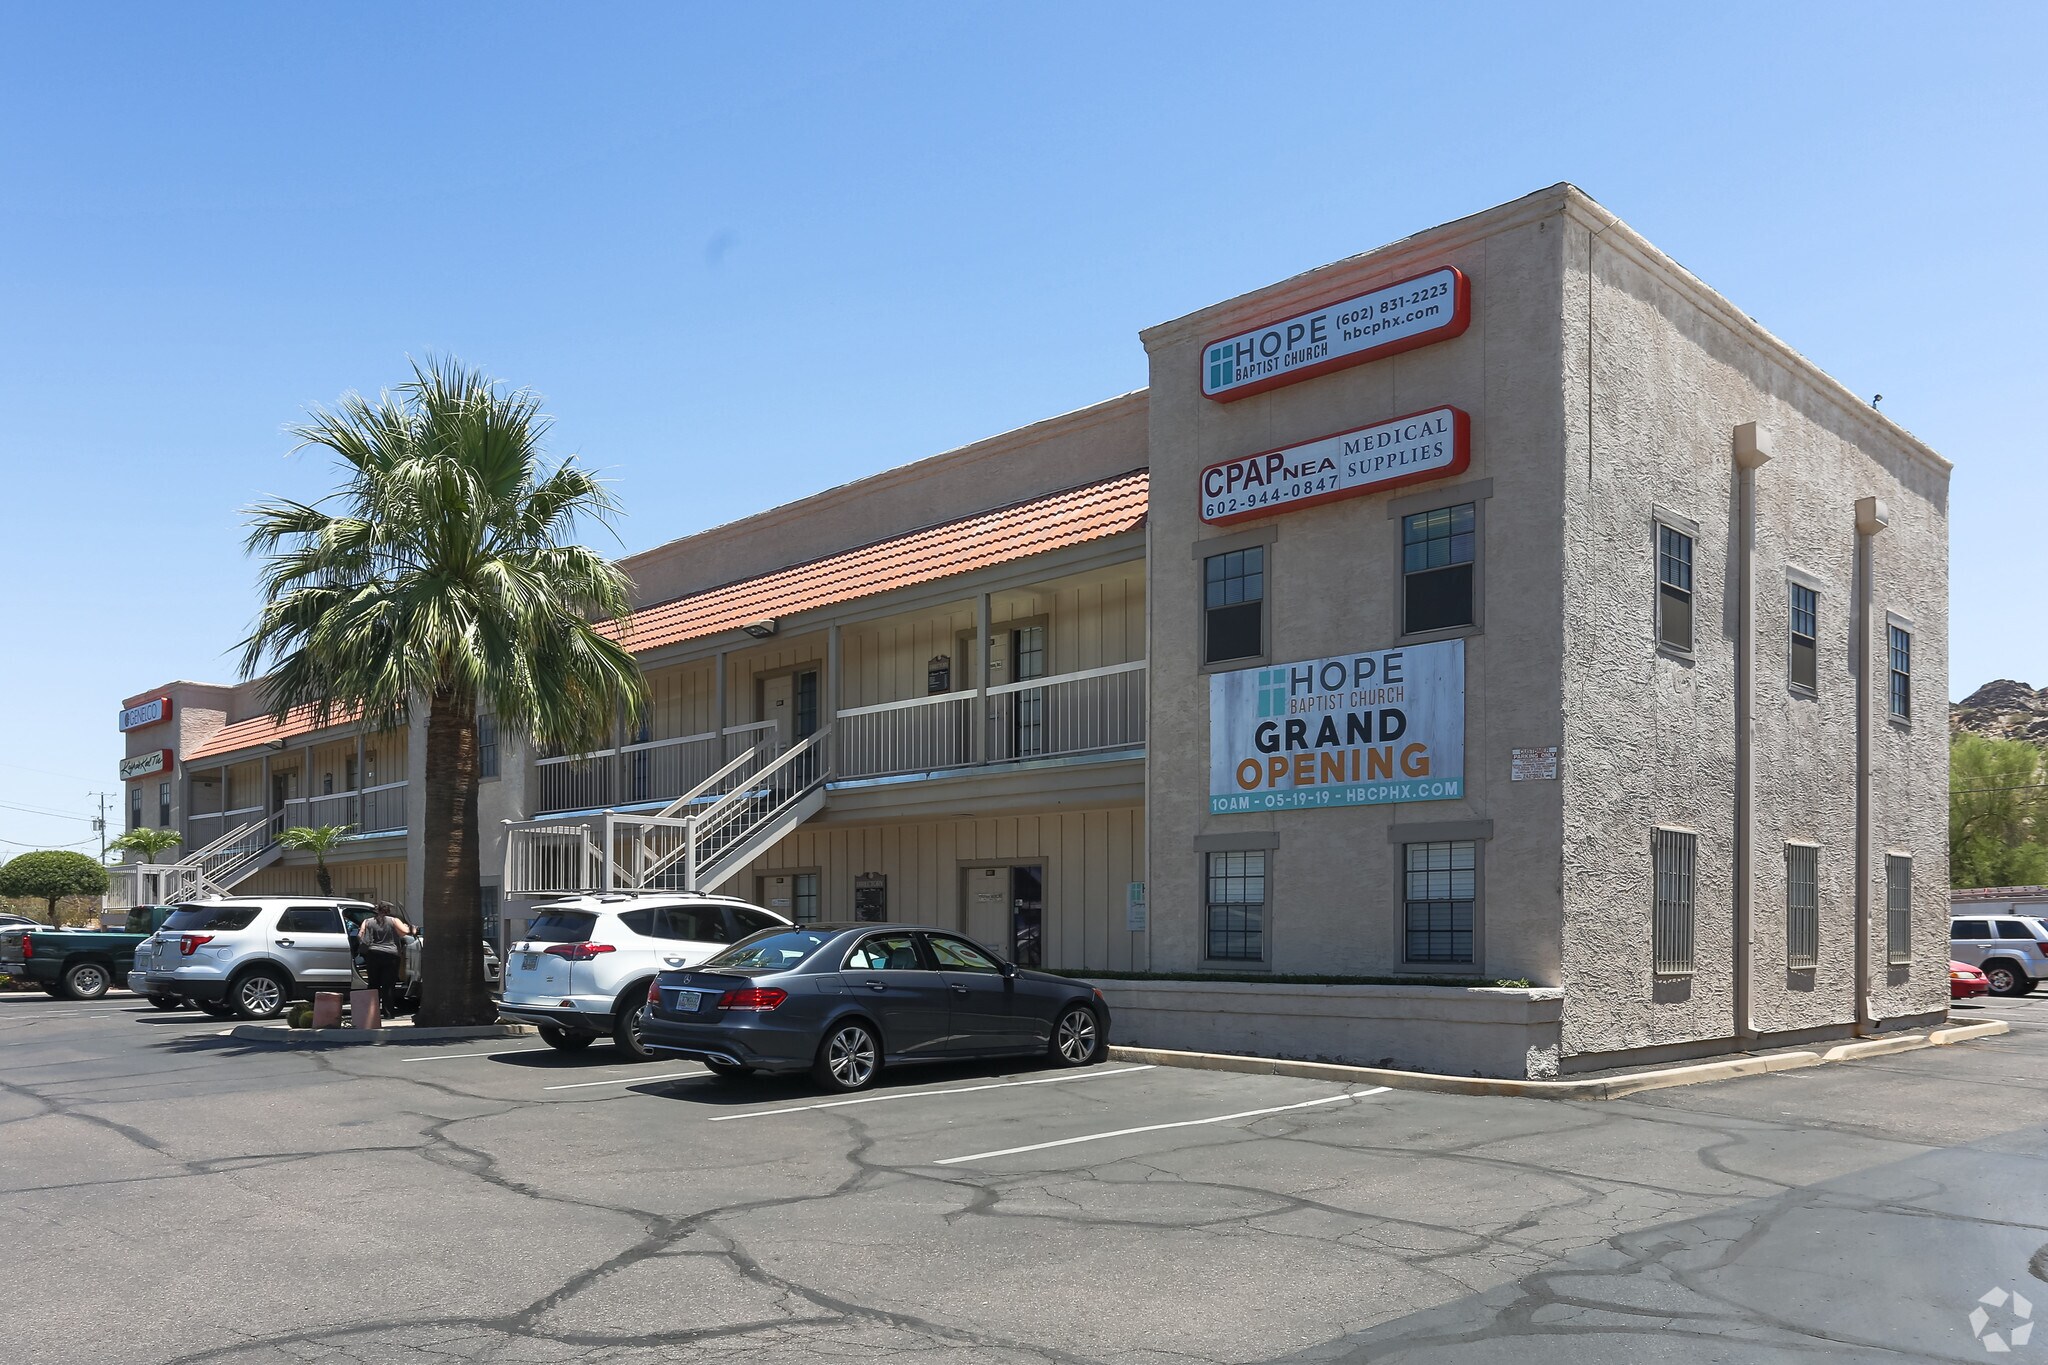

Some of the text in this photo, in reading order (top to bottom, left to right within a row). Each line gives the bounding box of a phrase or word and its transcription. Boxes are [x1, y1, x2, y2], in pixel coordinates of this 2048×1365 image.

[1336, 282, 1448, 330] (602) 831-2223
[1343, 304, 1440, 342] hbcphx.com
[1235, 314, 1328, 367] HOPE
[1235, 342, 1328, 382] BAPTIST CHURCH
[1343, 417, 1448, 457] MEDICAL
[1347, 441, 1444, 478] SUPPLIES
[1205, 474, 1339, 517] 602-944-0847
[1290, 652, 1404, 696] HOPE
[1290, 686, 1404, 715] BAPTIST CHURCH
[1254, 708, 1407, 754] GRAND
[1236, 742, 1430, 791] OPENING
[1212, 796, 1250, 812] 10AM
[1264, 790, 1330, 808] 05-19-19
[1346, 780, 1458, 802] HBCPHX.COM
